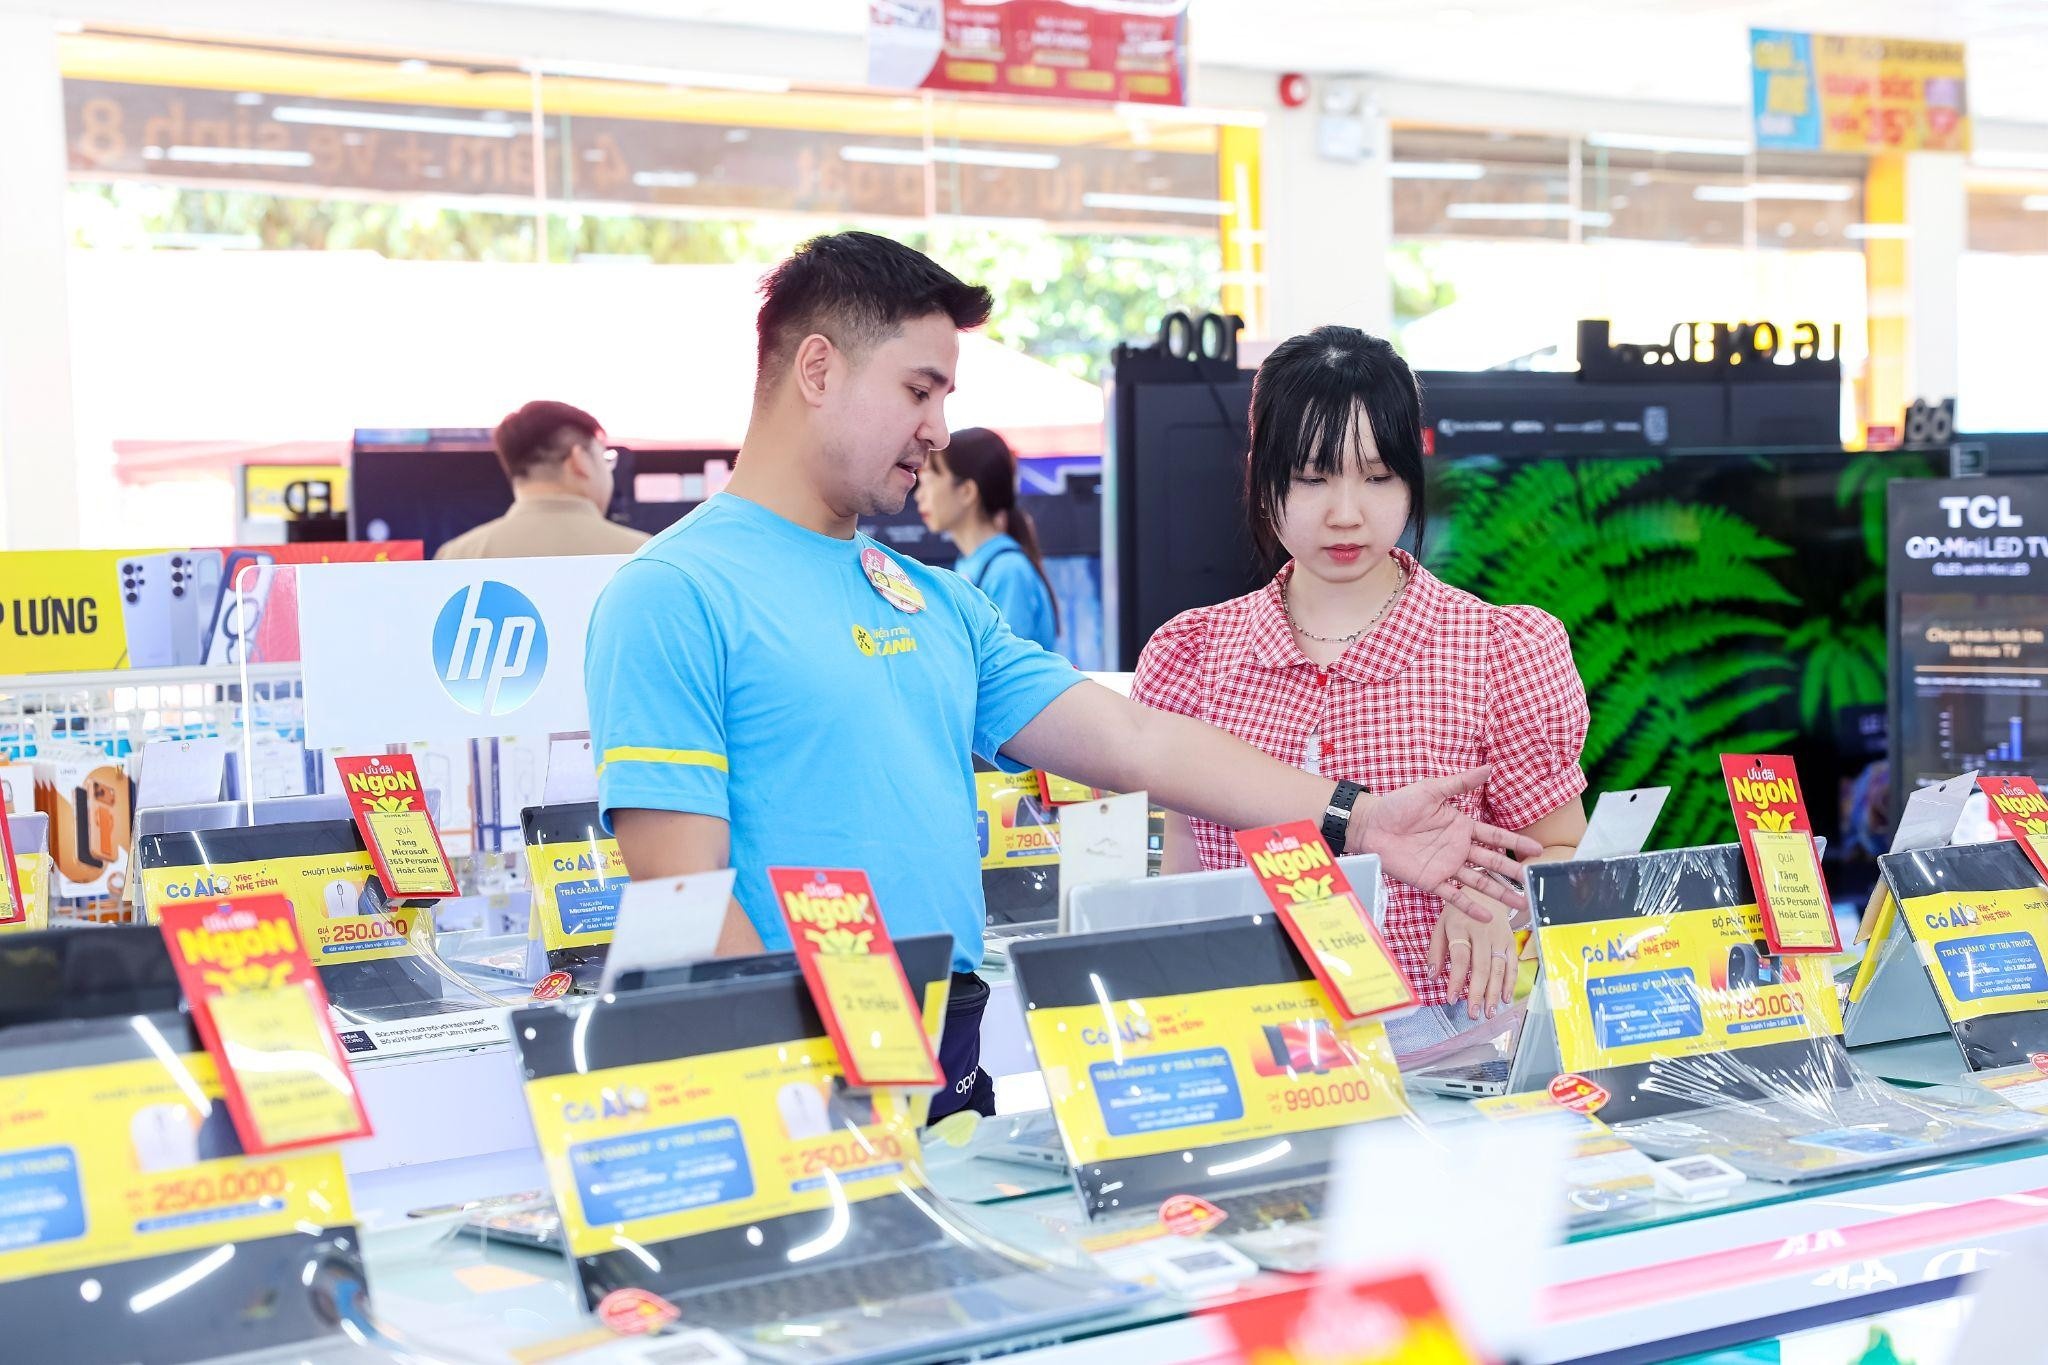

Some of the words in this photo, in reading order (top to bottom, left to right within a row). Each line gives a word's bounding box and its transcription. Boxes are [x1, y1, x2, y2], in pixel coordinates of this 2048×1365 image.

[1939, 495, 2023, 529] TCL
[13, 596, 98, 636] LƯNG
[445, 580, 537, 715] hp
[348, 771, 417, 796] NgoN
[1747, 768, 1761, 780] Ưu
[1761, 769, 1776, 780] đãi
[1732, 777, 1798, 810] NgoN
[391, 848, 429, 856] Microsoft
[405, 857, 440, 865] Personal
[553, 857, 575, 872] Có
[1779, 870, 1799, 882] Tặng
[166, 882, 191, 898] Có
[1771, 896, 1786, 906] 365
[1787, 896, 1821, 907] Personal
[1777, 909, 1799, 922] Hoặc
[1926, 912, 1949, 929] Có
[332, 919, 408, 943] 250.000
[1284, 1080, 1371, 1112] 990.000
[801, 1135, 902, 1174] 250.000
[152, 1165, 288, 1210] 250.000
